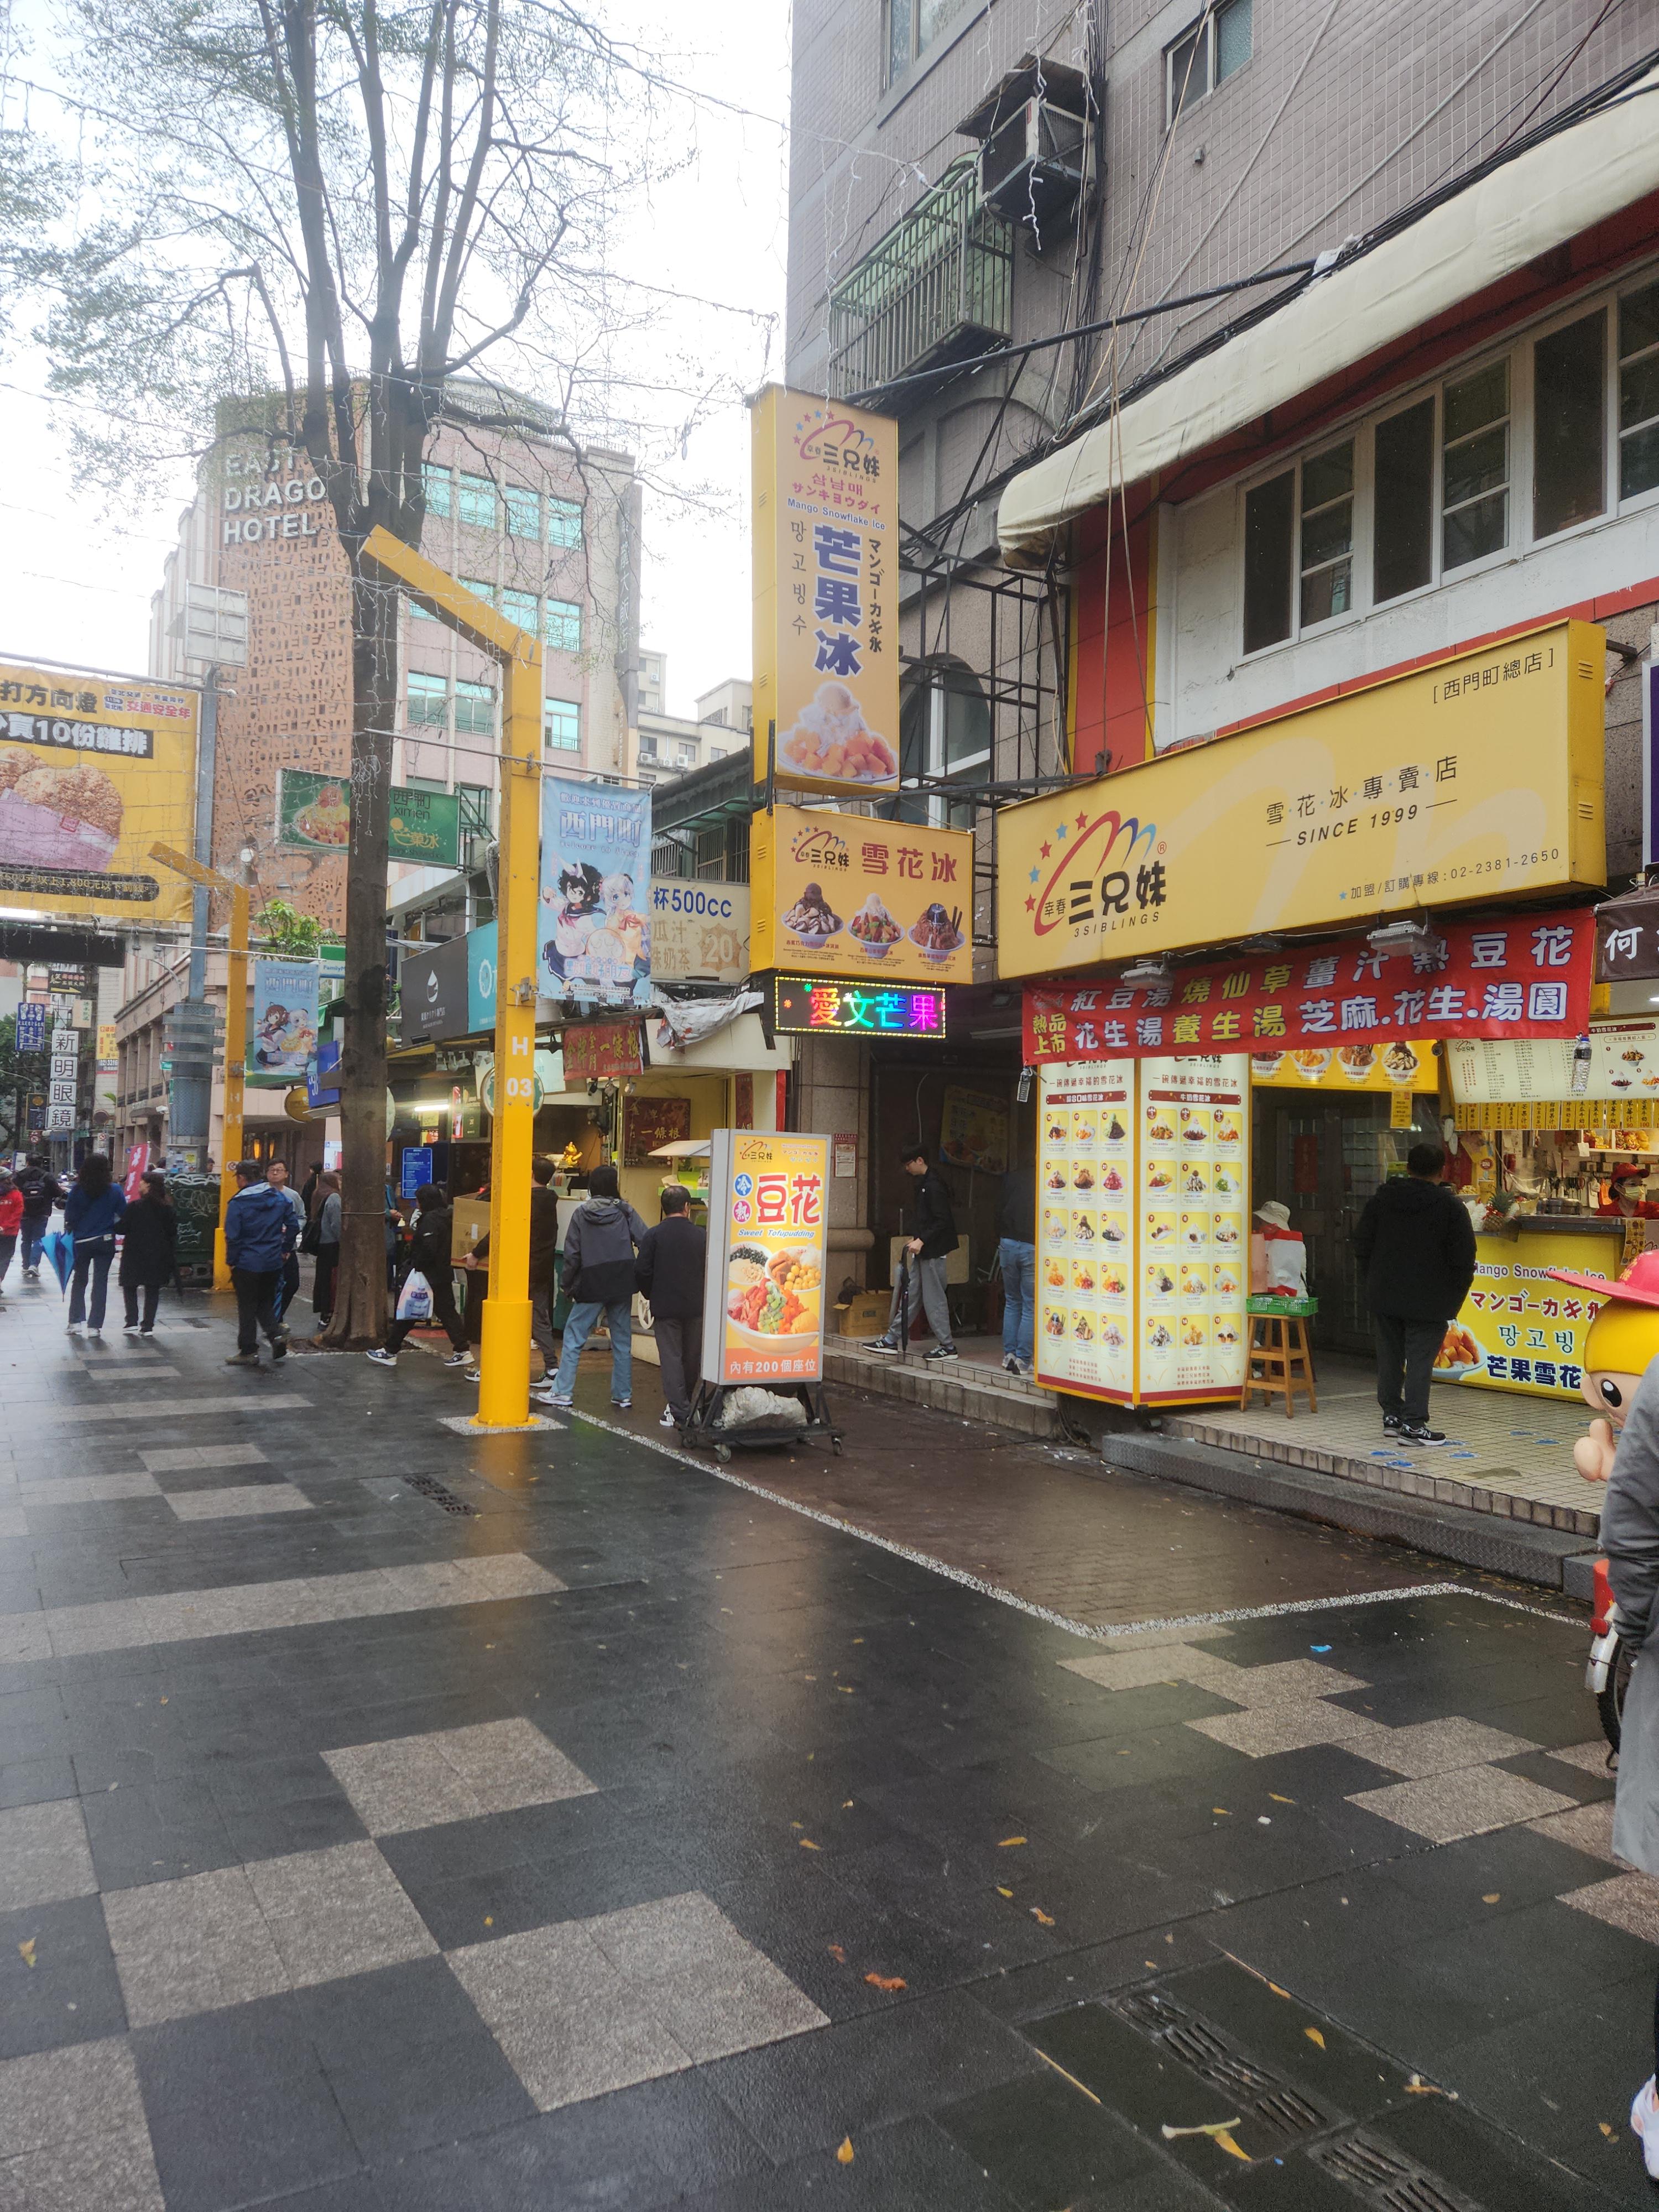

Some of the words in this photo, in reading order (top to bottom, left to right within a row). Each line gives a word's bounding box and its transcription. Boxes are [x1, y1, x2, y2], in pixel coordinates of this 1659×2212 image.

[823, 442, 880, 477] 三兄妹
[812, 473, 863, 497] 삼남매
[224, 513, 317, 544] HOTEL
[787, 498, 818, 514] Mango
[822, 507, 869, 526] Snowflake
[873, 520, 885, 530] Ice
[791, 520, 807, 637] 망고빙수
[814, 524, 862, 676] 芒果冰
[127, 701, 191, 719] 交通安全年
[0, 713, 148, 755] 買10份雞排
[394, 807, 430, 820] ximen
[1297, 818, 1358, 846] SINCE
[1370, 804, 1418, 828] 1999
[560, 810, 642, 848] 西門町
[811, 848, 849, 868] 三兄妹
[861, 842, 957, 883] 雪花冰
[1069, 860, 1167, 925] 三兄妹
[1074, 912, 1160, 938] 3SIBLINGS
[706, 933, 733, 963] 20
[1180, 963, 1294, 1005] 燒仙草
[809, 987, 938, 1030] 愛文芒果
[1070, 987, 1173, 1012] 紅豆湯
[1074, 1016, 1162, 1049] 花生湯
[1172, 1004, 1287, 1045] 養生湯
[512, 1036, 528, 1056] H
[1034, 1034, 1066, 1055] 上市
[51, 1034, 75, 1126] 新明眼鏡
[506, 1077, 532, 1098] 03
[641, 1127, 681, 1139] 一條根
[750, 1151, 773, 1160] 三兄妹
[735, 1176, 752, 1195] 冷
[756, 1173, 822, 1224] 豆花
[734, 1203, 750, 1221] 熱
[767, 1229, 815, 1239] Tofupudding
[1499, 1325, 1585, 1354] 망고빙
